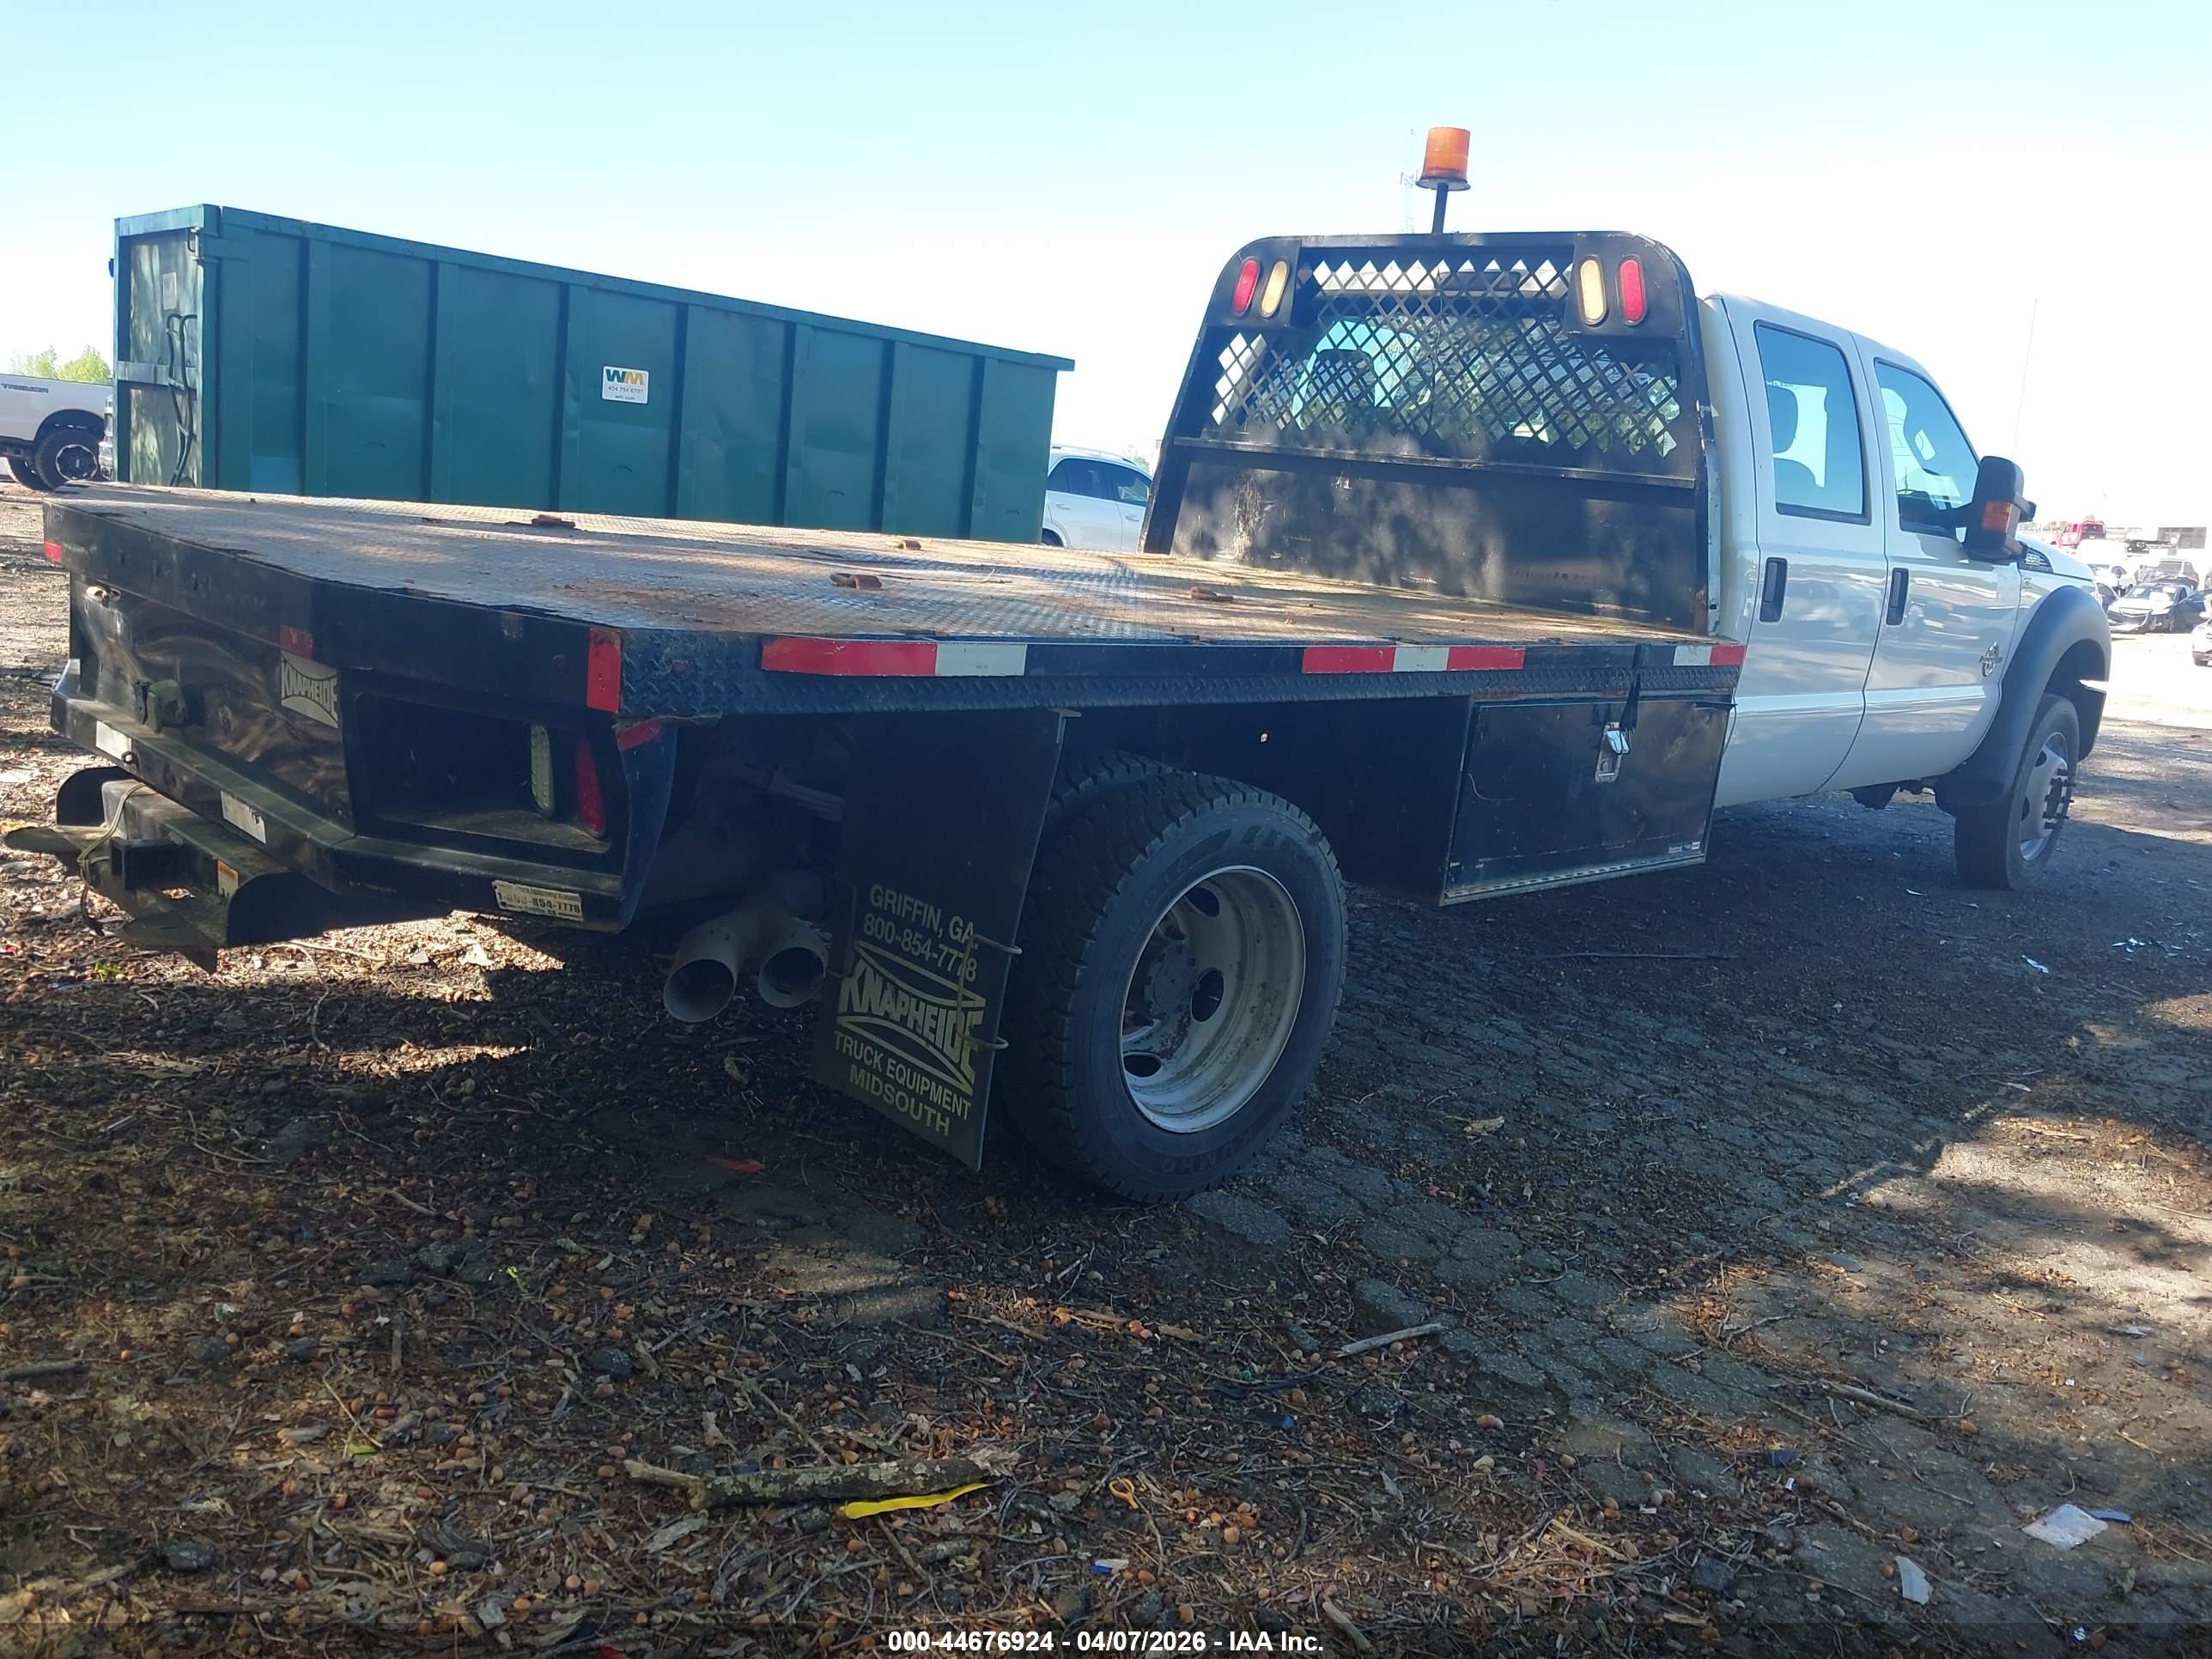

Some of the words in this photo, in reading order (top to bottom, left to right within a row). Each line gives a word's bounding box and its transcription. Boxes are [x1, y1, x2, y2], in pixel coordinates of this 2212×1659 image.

[605, 369, 644, 386] WM
[281, 654, 337, 722] KNAPHEIDE
[869, 884, 944, 939] GRIFFIN,
[837, 959, 984, 1085] KNAPHEIDE
[833, 1030, 884, 1073] TRUCK
[885, 1057, 972, 1121] EQUIPMENT
[849, 1064, 951, 1137] MIDSOUTH
